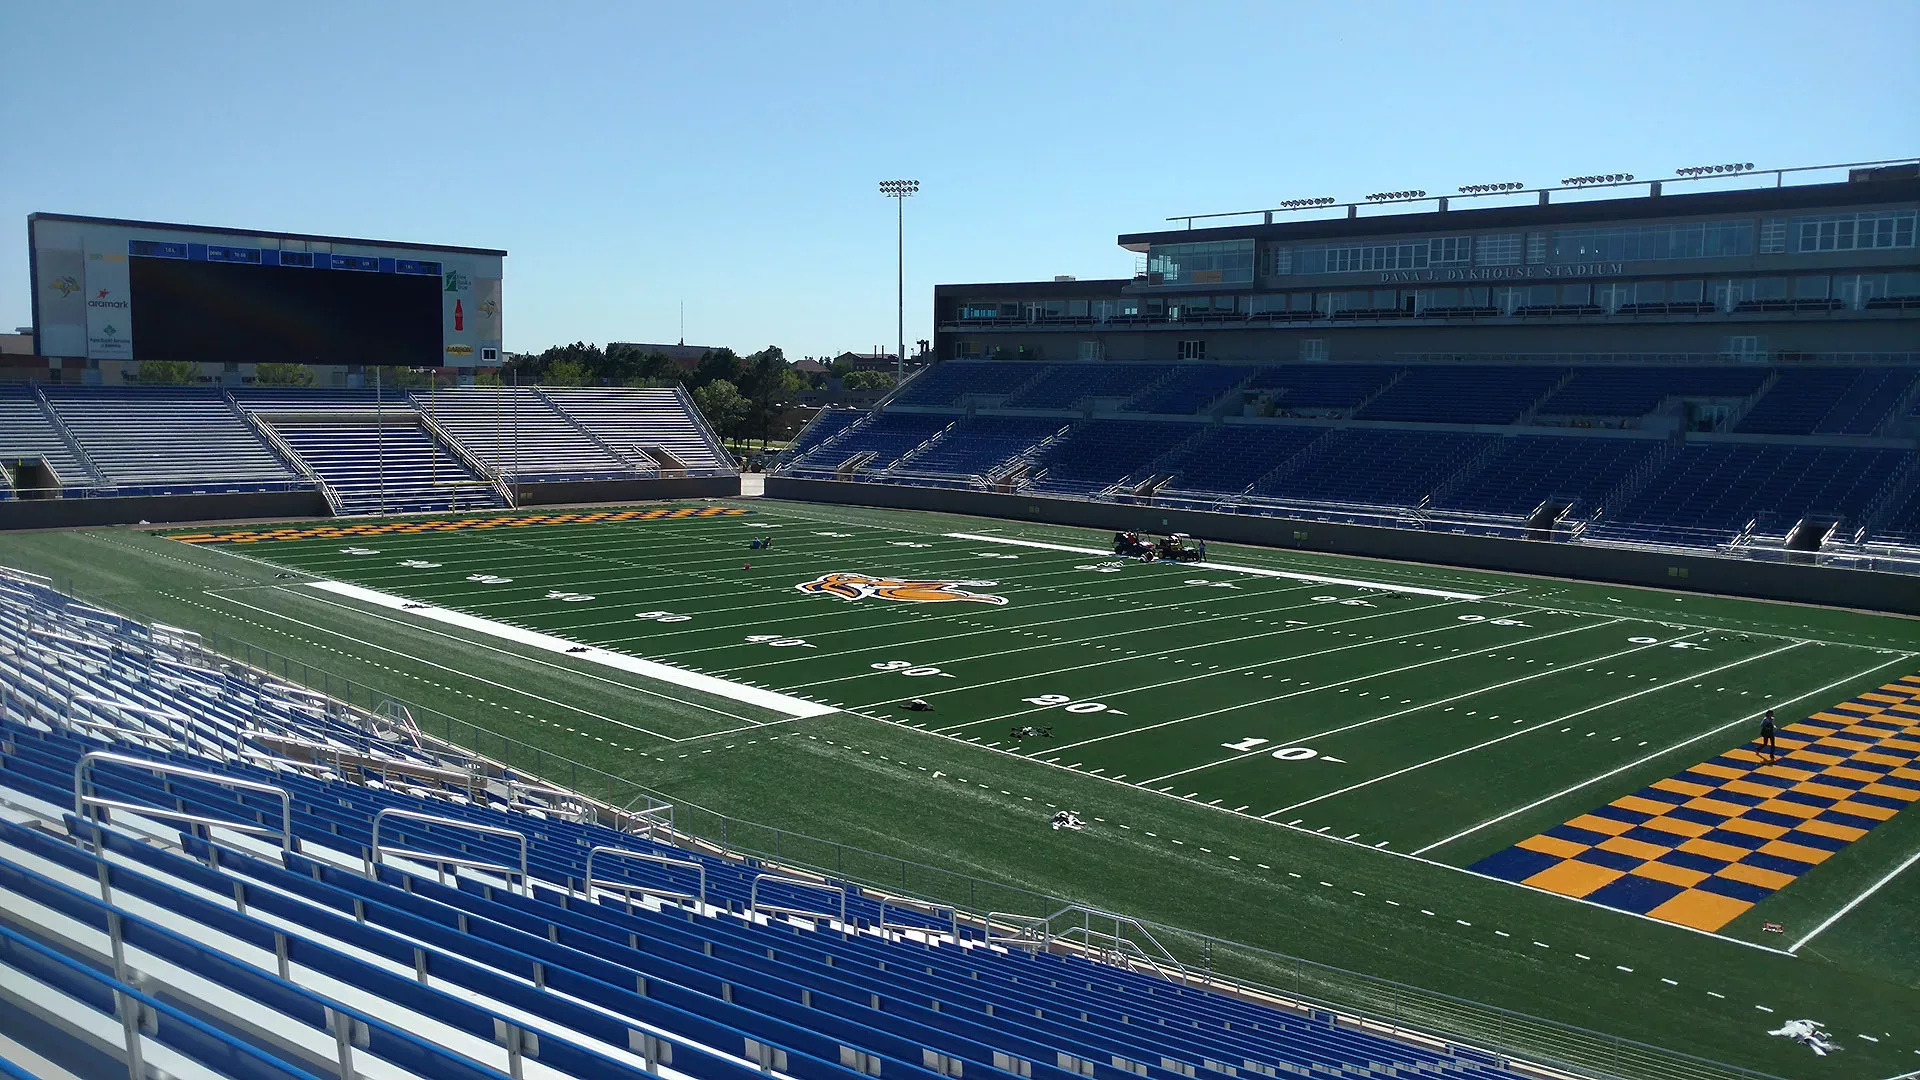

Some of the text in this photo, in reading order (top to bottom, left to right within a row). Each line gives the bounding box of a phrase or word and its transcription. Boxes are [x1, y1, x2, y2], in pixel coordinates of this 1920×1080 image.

[1381, 263, 1624, 282] DANA J. DYKHOUSE STADIUM
[88, 300, 129, 308] aramark
[871, 660, 941, 676] 30
[1021, 694, 1108, 713] 20
[1221, 737, 1318, 760] 10
